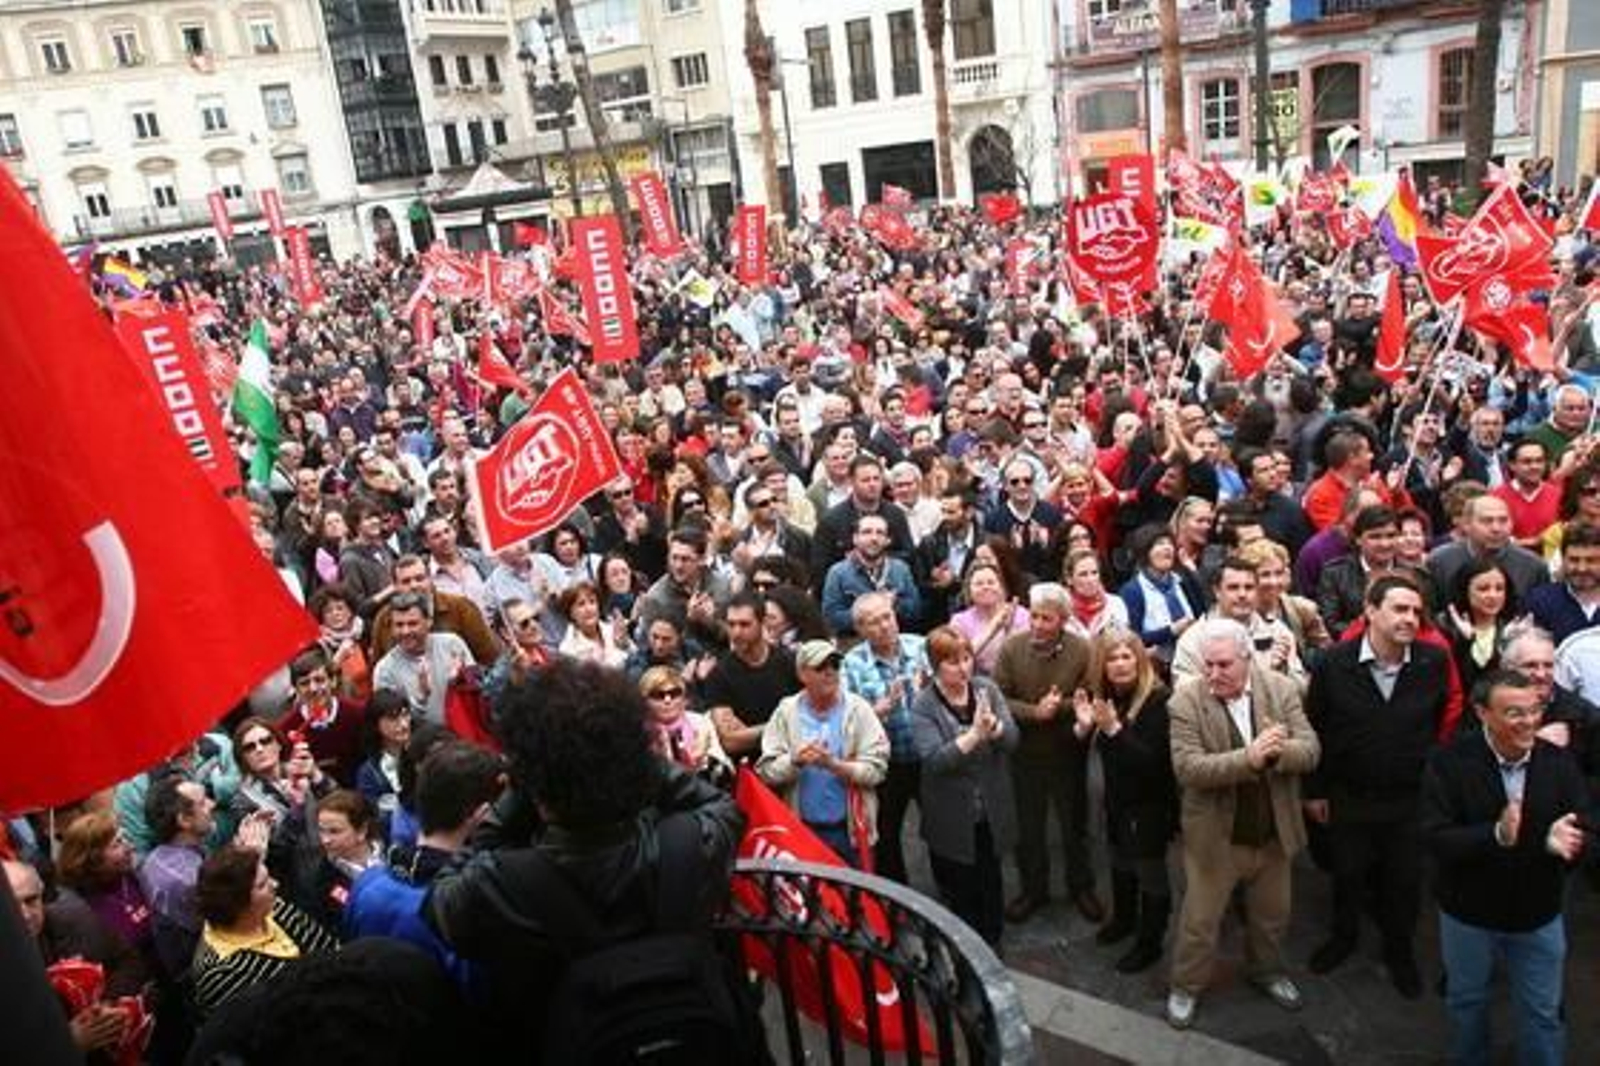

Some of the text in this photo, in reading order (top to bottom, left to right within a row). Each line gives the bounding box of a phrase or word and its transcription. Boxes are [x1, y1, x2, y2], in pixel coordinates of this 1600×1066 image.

[639, 179, 668, 233] CCOO
[1076, 199, 1138, 240] UGT
[587, 230, 618, 316] CCOO
[142, 325, 204, 436] CCOO
[503, 423, 561, 495] UGT
